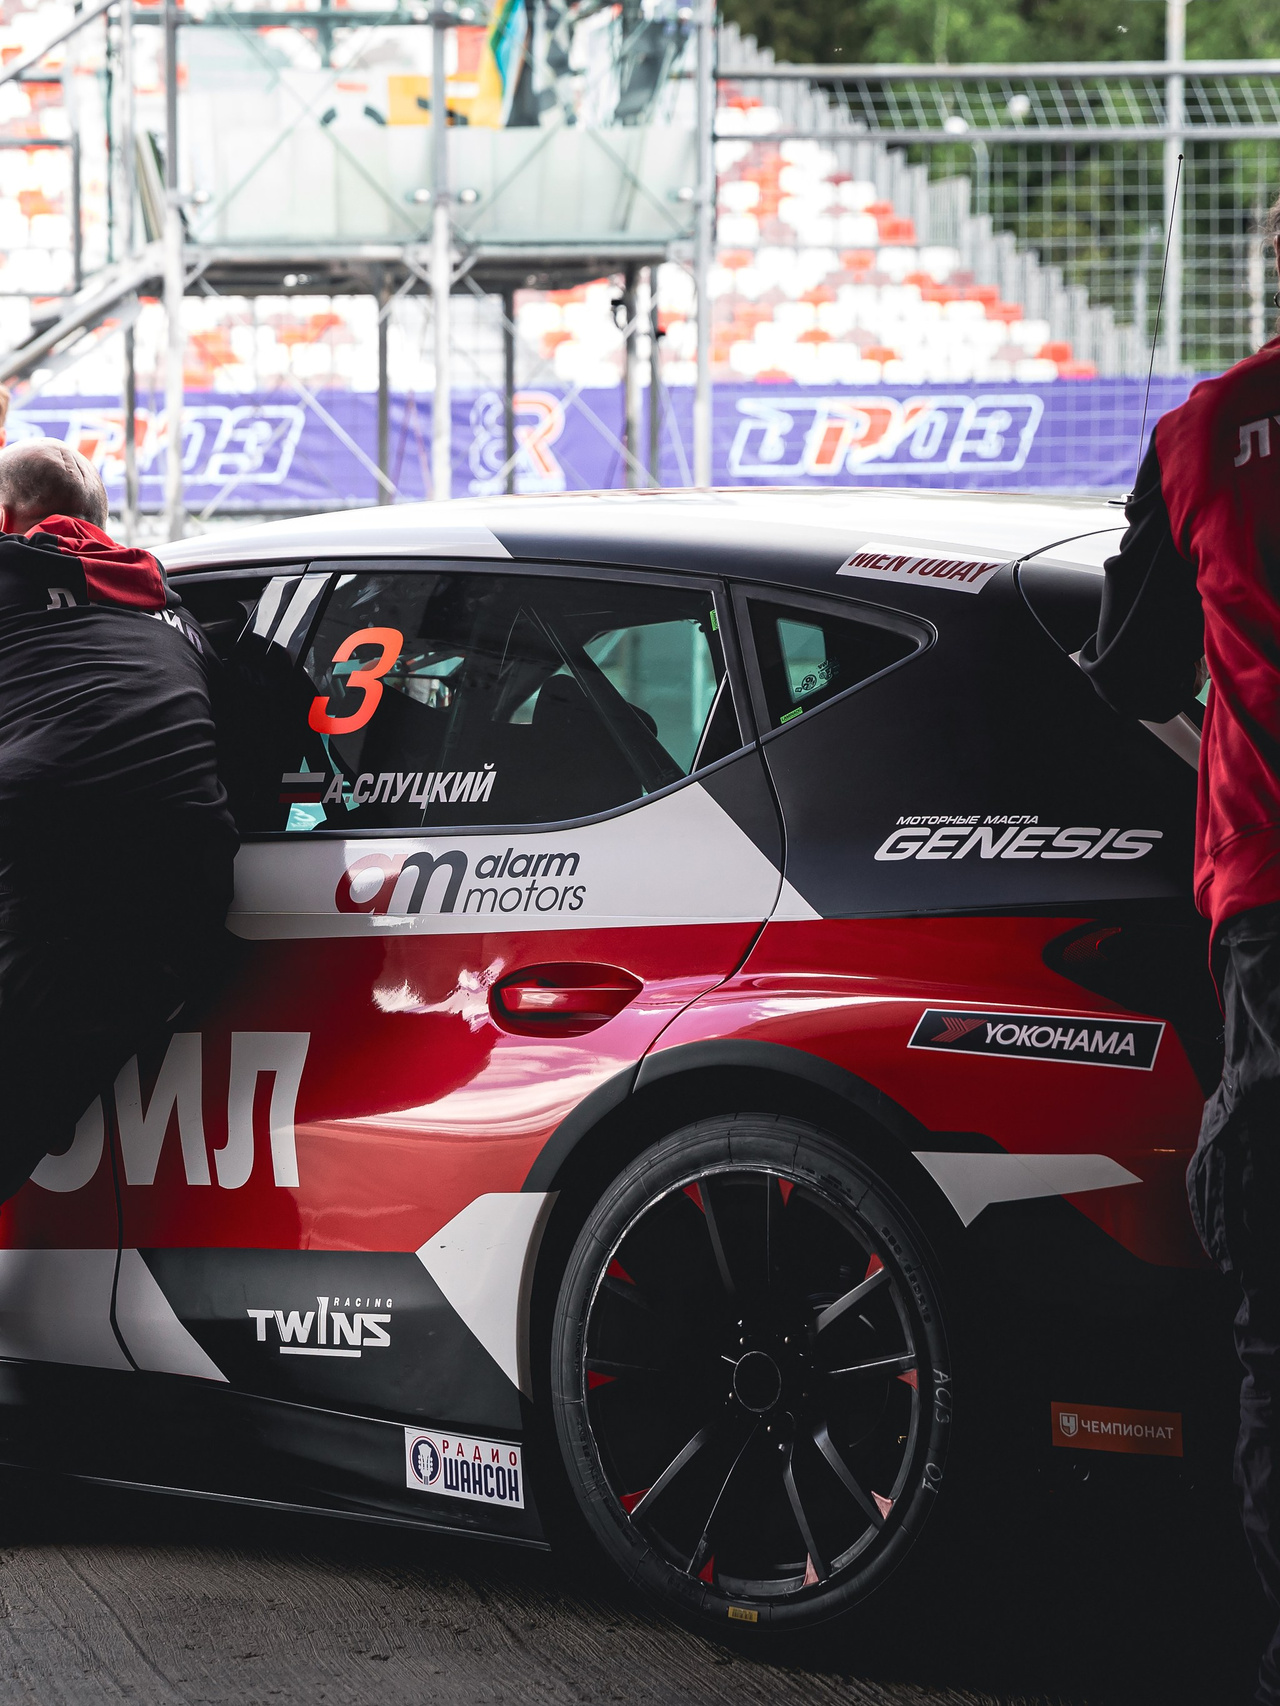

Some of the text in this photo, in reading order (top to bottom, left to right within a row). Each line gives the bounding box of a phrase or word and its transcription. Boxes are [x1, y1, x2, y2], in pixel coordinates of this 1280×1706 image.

[847, 552, 910, 573] MEN
[307, 626, 404, 735] 3
[895, 815, 1039, 826] МОТОРНЫЕ МАСЛА
[873, 826, 1164, 861] GENESIS
[473, 847, 580, 879] alarm
[463, 880, 586, 914] motors
[984, 1022, 1137, 1058] YOKOHAMA
[332, 1297, 395, 1309] RACING
[1080, 1417, 1176, 1442] ЧЕМПИОНАТ
[442, 1438, 519, 1467] РАДИО
[443, 1456, 522, 1503] ШАНСОН
